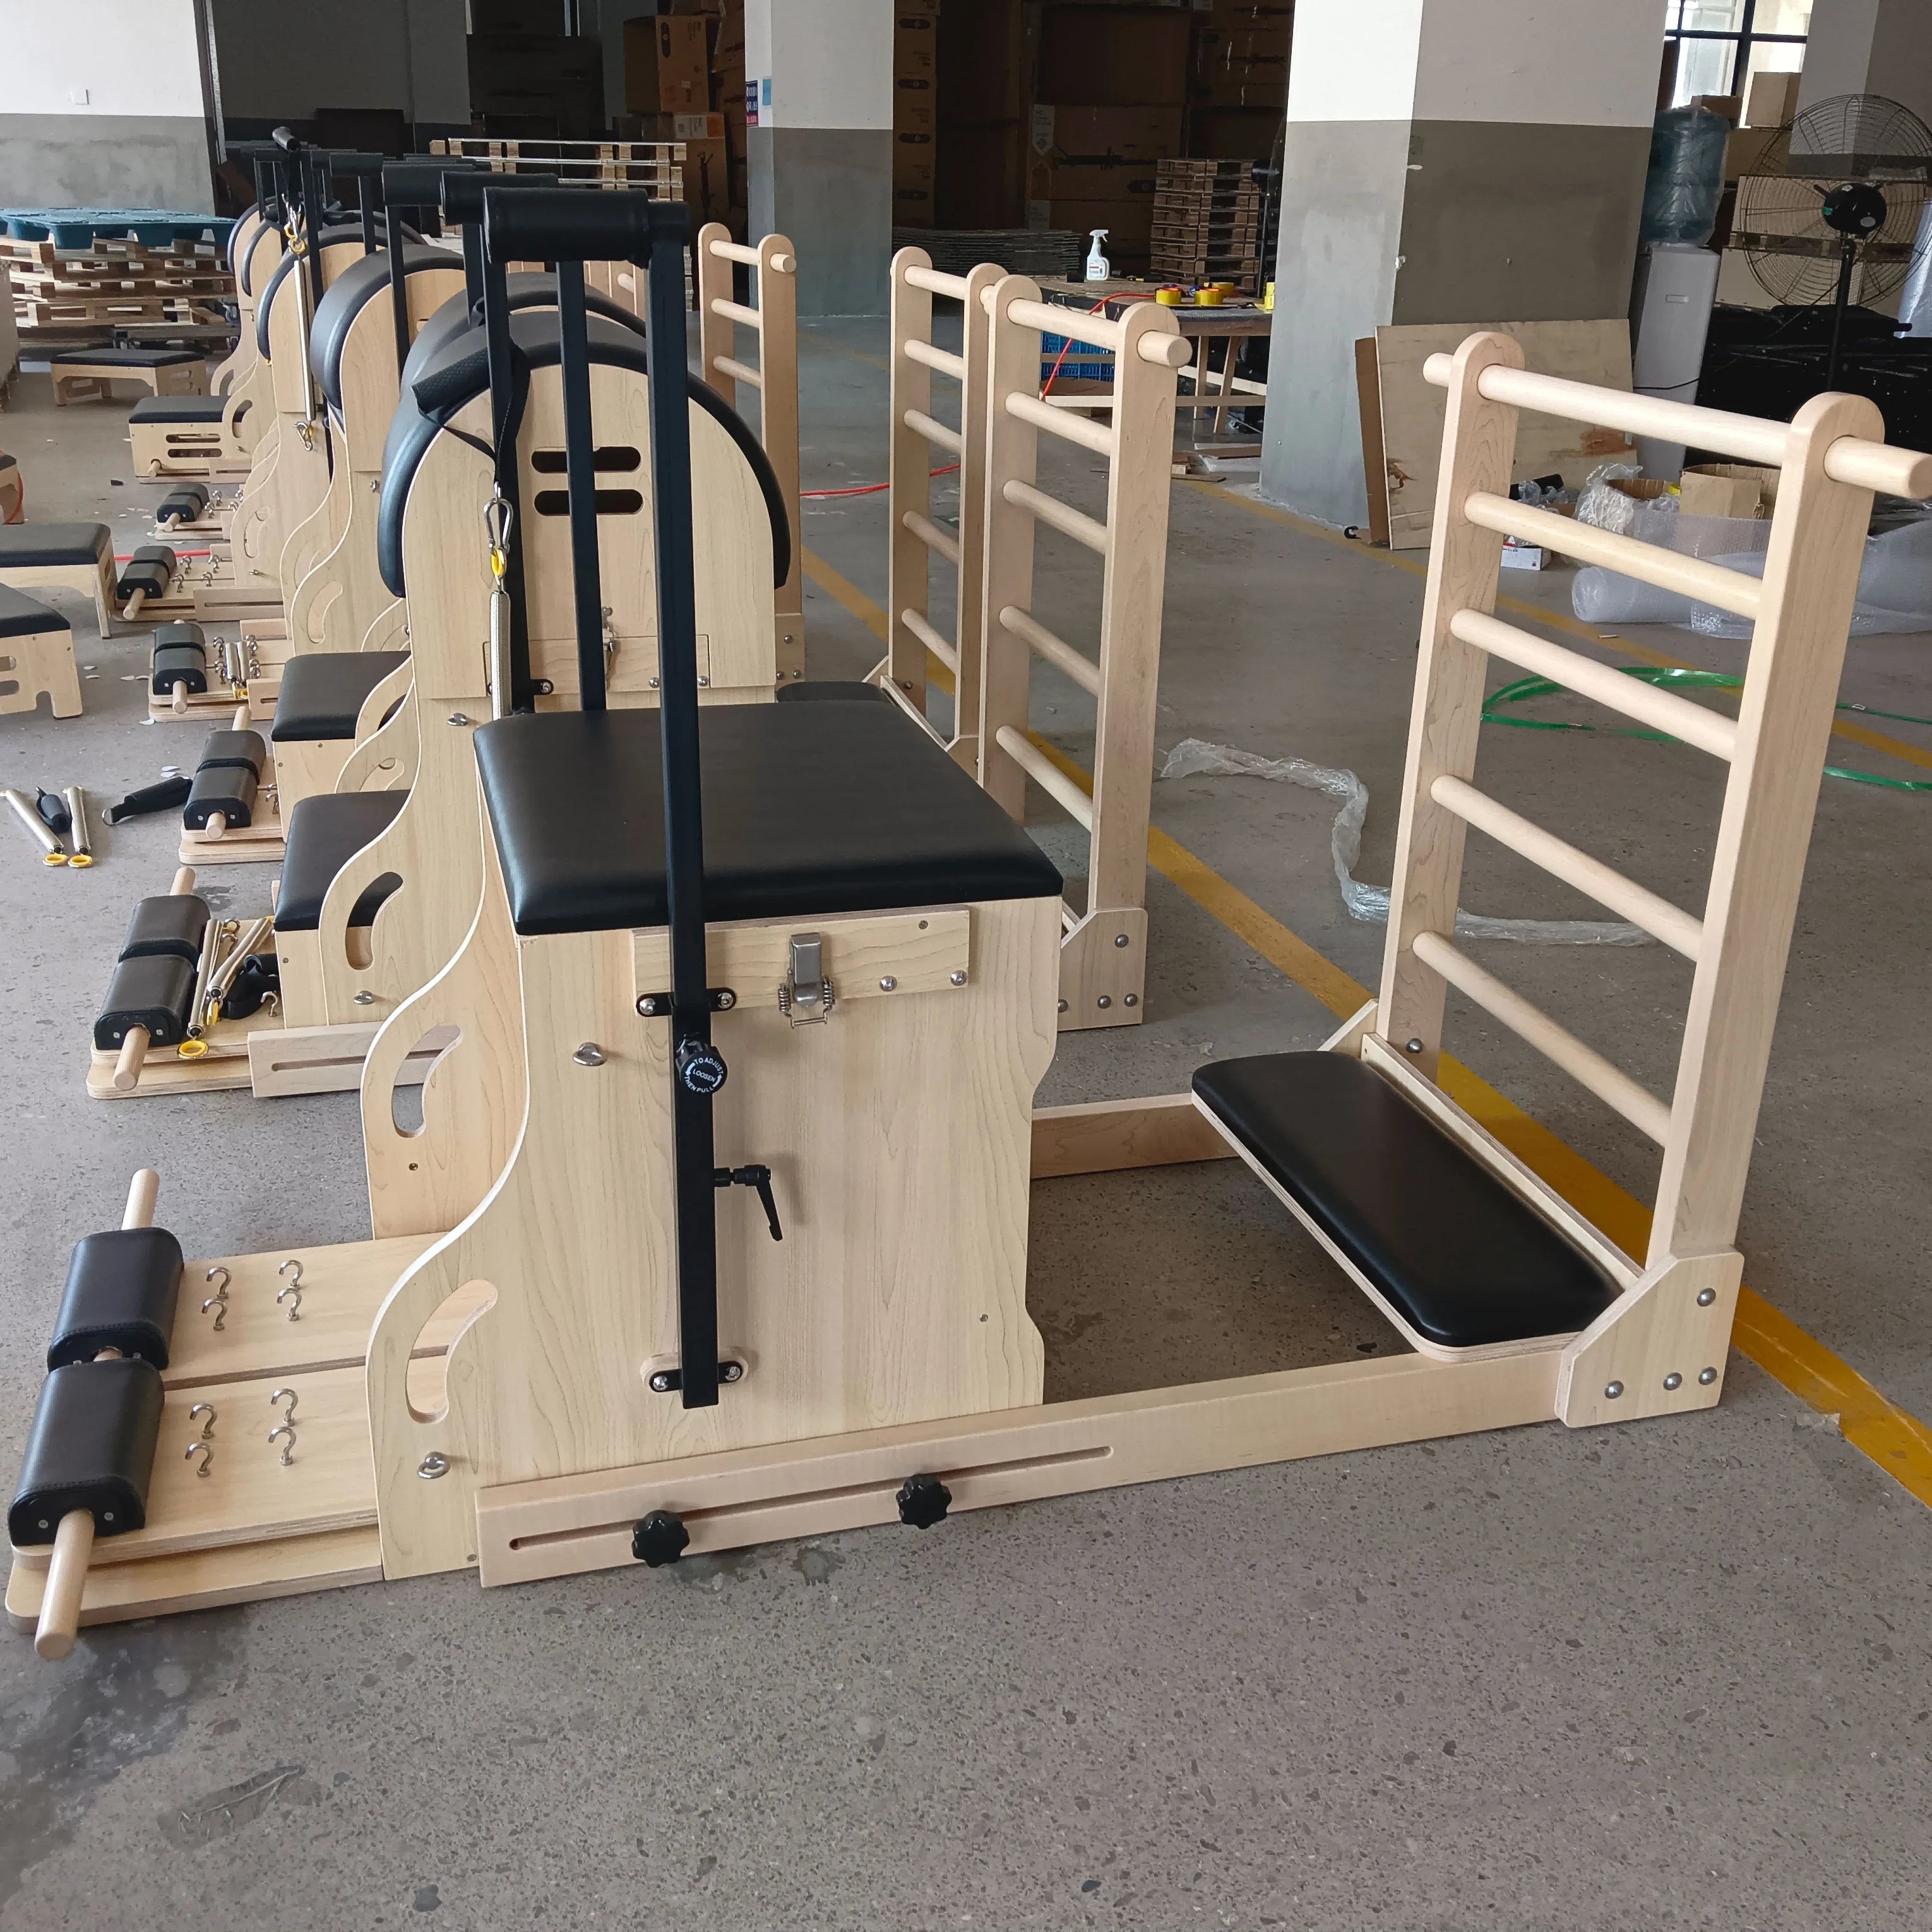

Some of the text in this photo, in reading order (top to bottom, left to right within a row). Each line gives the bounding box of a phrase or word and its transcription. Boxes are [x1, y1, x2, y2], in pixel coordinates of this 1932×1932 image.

[704, 1057, 724, 1074] ADJUST
[693, 1068, 716, 1082] LOOSEN
[684, 1076, 696, 1090] THEN
